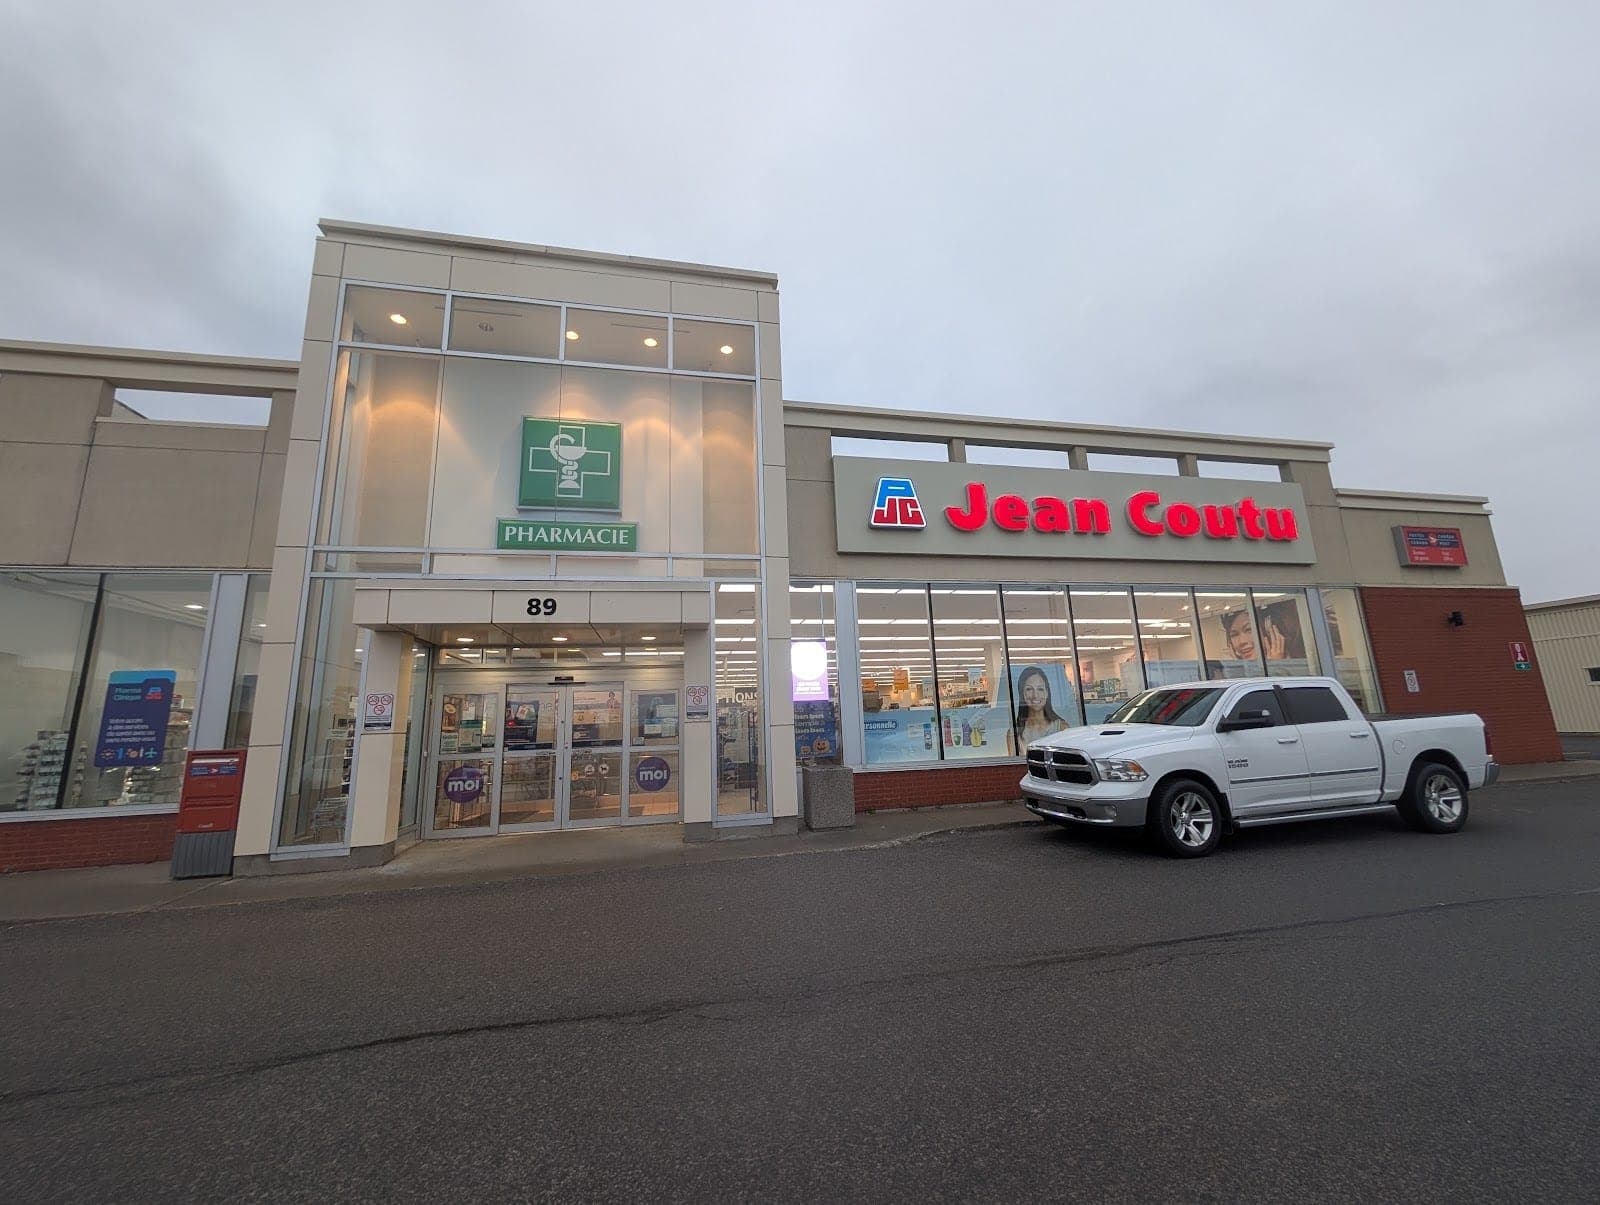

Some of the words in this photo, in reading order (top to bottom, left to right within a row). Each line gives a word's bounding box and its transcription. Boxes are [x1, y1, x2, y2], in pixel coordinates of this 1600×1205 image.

[944, 482, 1112, 533] Jean
[1125, 490, 1298, 541] Coutu
[504, 526, 629, 545] PHARMACIE
[526, 598, 557, 615] 89
[639, 769, 668, 781] moi
[447, 779, 480, 797] moi
